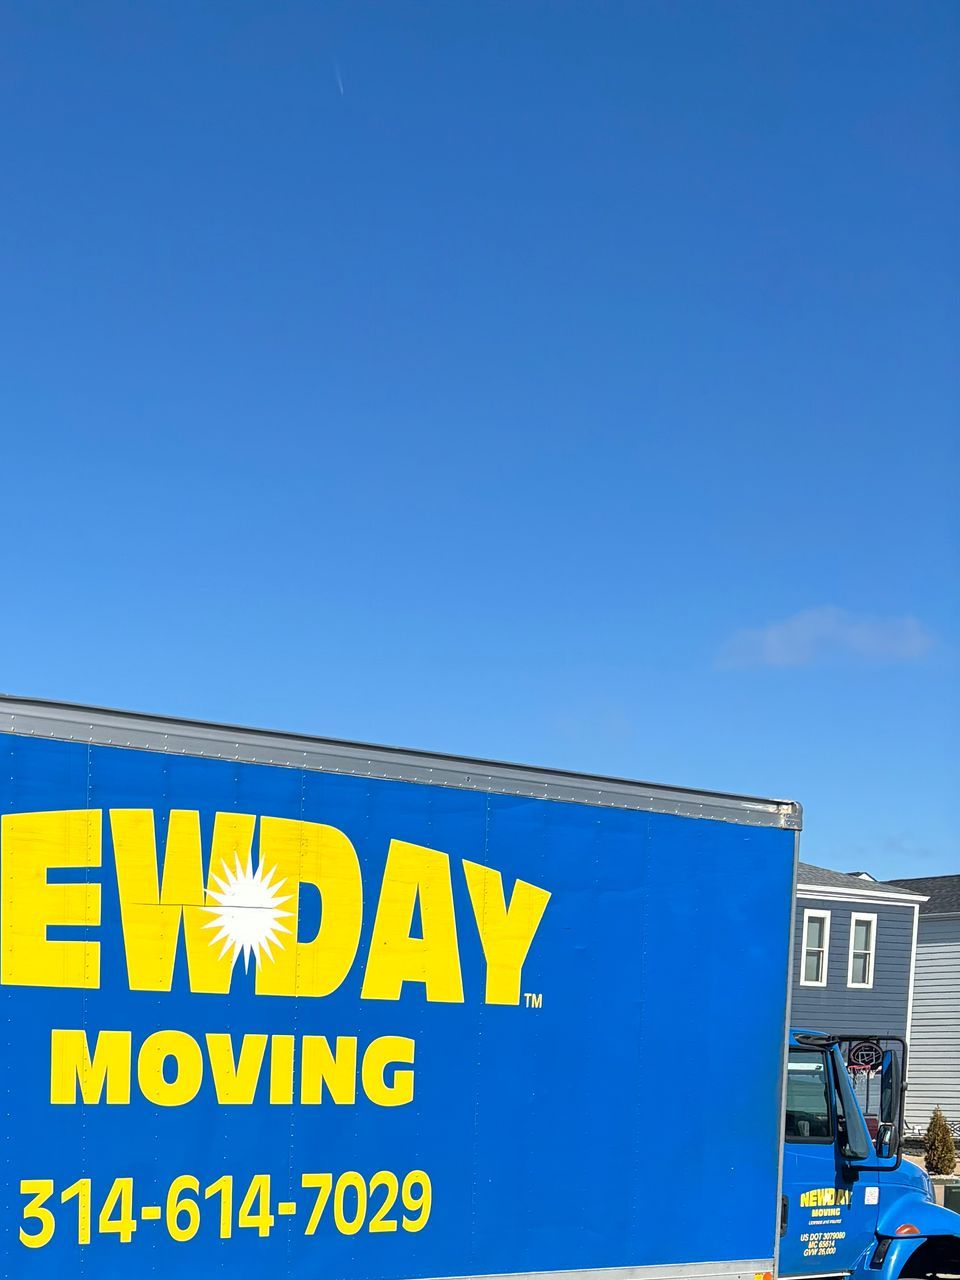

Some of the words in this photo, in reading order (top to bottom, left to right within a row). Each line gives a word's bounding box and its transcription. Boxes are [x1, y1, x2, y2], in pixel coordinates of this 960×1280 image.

[50, 1029, 415, 1107] MOVING
[19, 1170, 432, 1249] 314-614-7029
[811, 1208, 841, 1218] MOVING
[800, 1233, 809, 1241] US
[810, 1232, 823, 1240] DOT
[808, 1241, 818, 1249] MC
[803, 1248, 818, 1257] GVW
